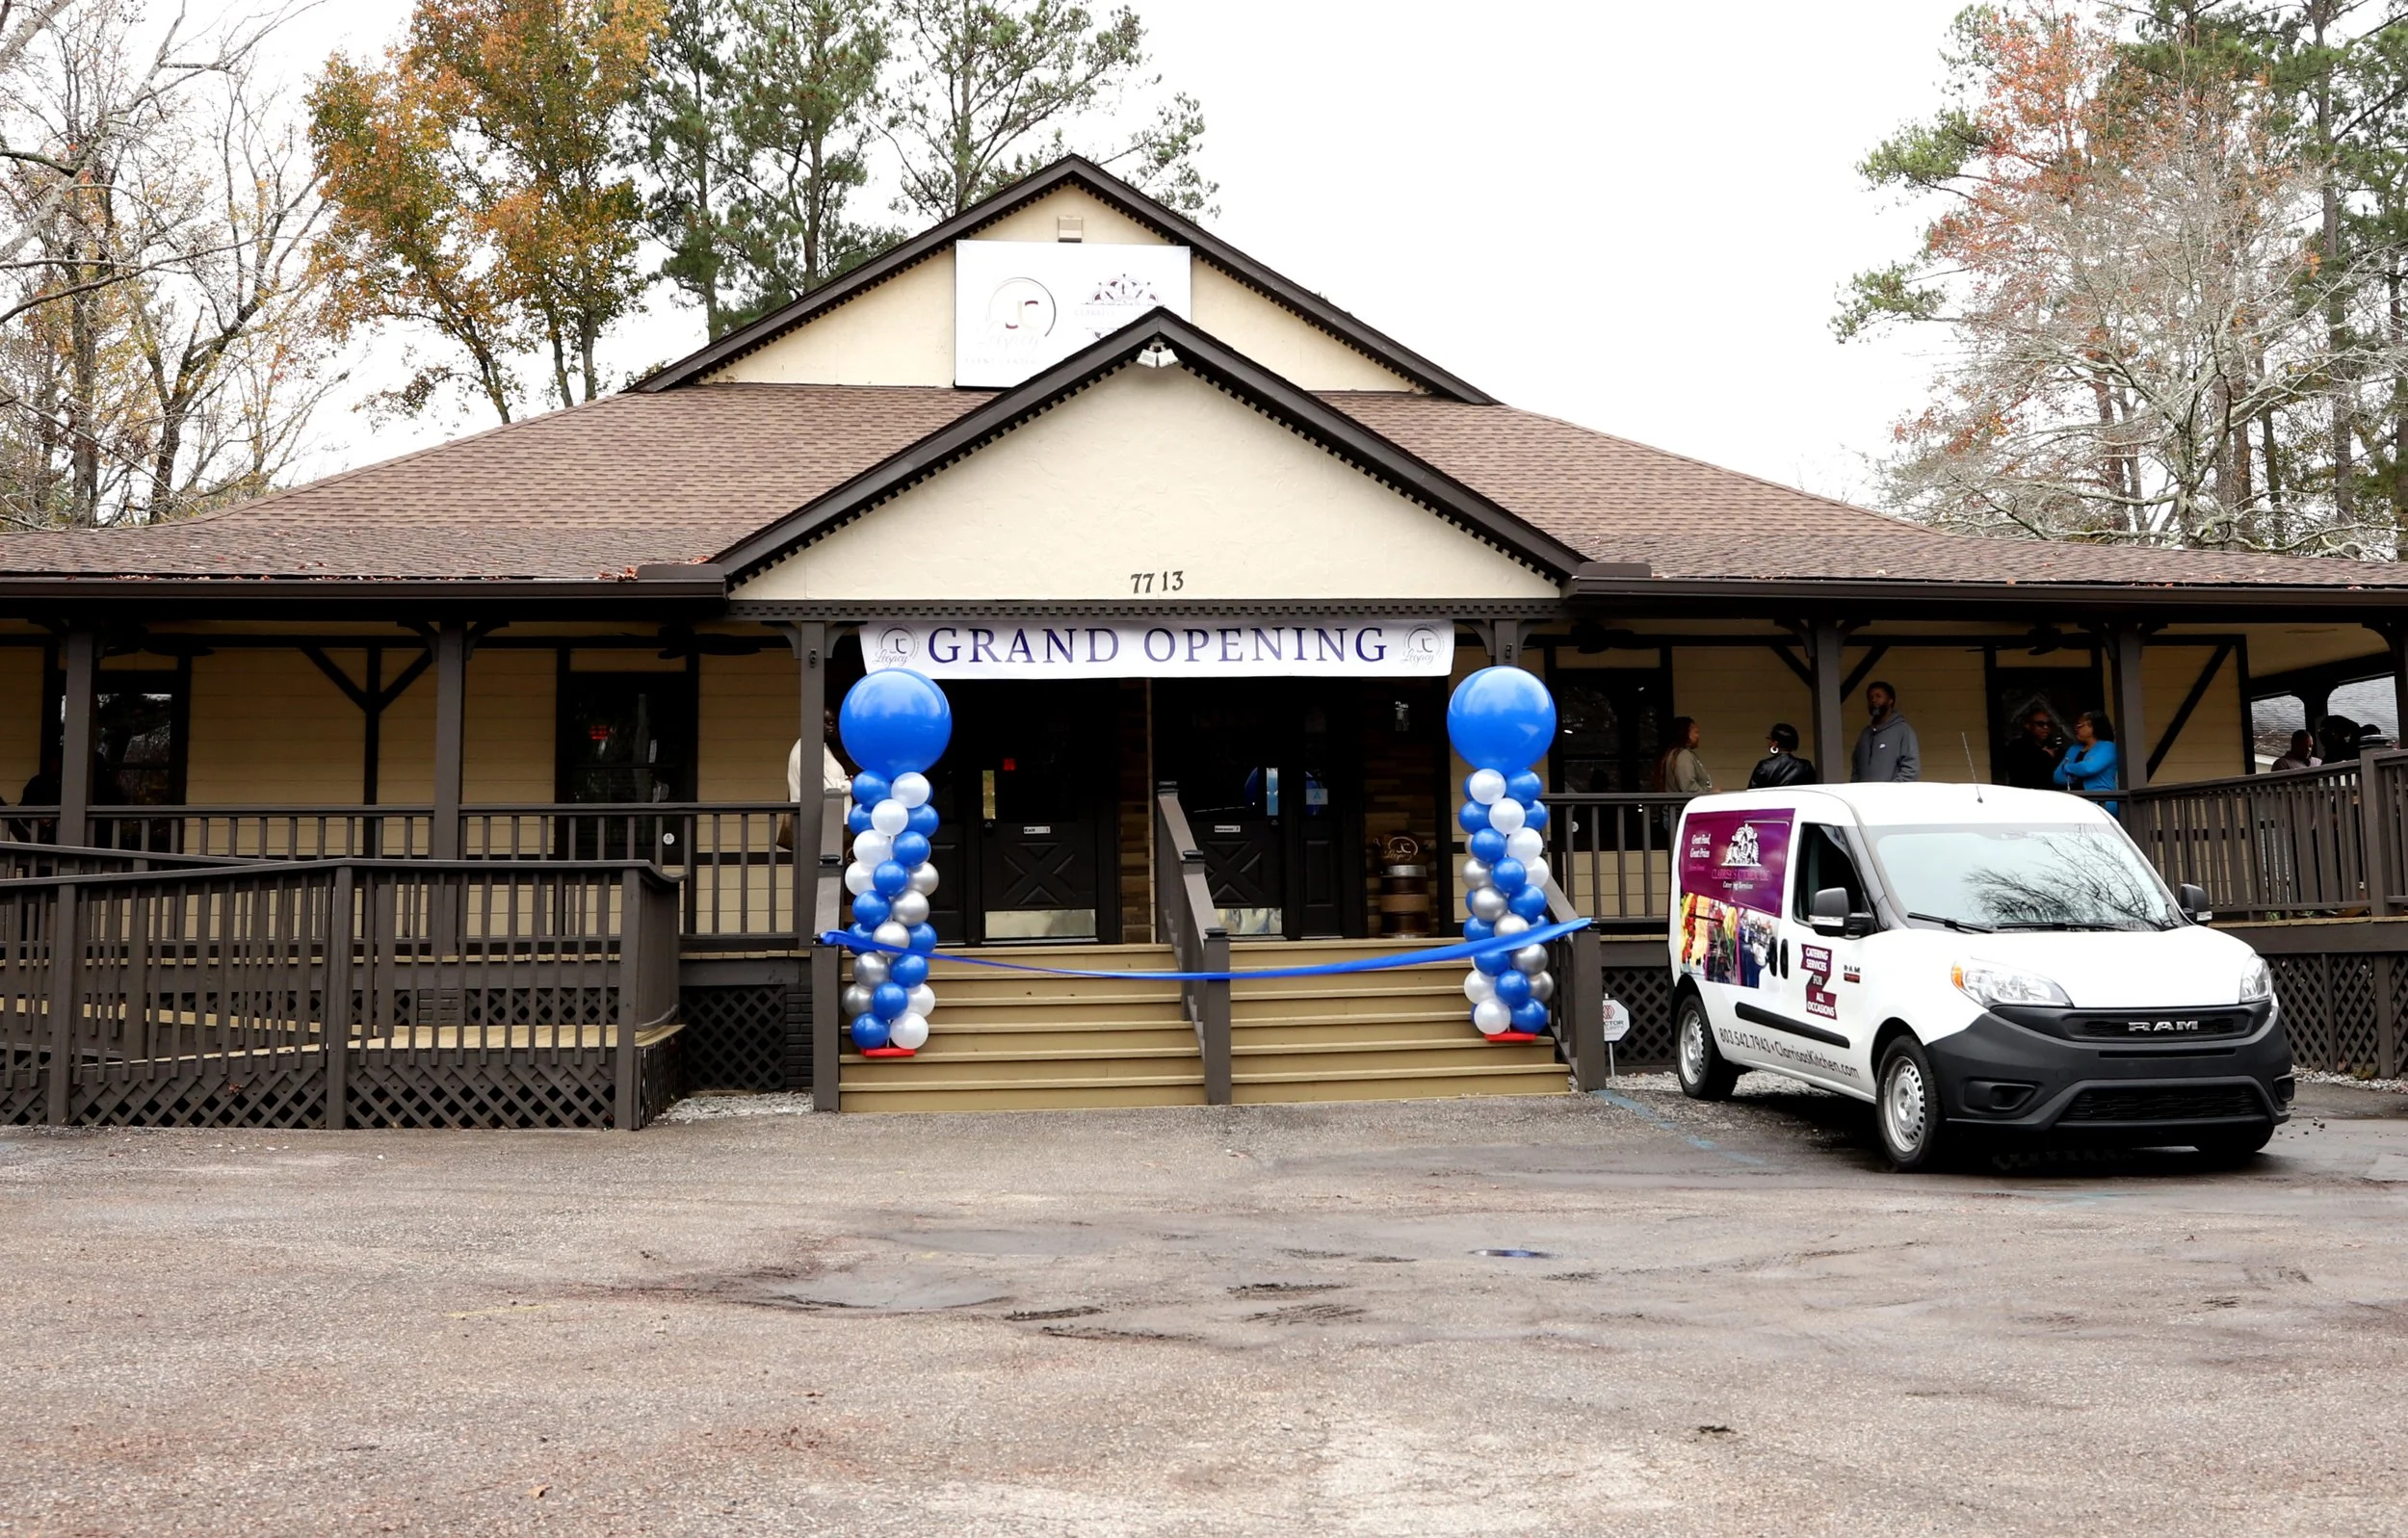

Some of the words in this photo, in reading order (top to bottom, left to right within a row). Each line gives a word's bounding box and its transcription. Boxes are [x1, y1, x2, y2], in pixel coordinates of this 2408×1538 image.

[1131, 570, 1184, 594] 7713
[929, 627, 1119, 664] GRAND
[1143, 627, 1387, 663] OPENING
[1805, 947, 1828, 961] CATERING
[1806, 958, 1827, 972] SERVICES
[1813, 975, 1823, 985] FOR
[1816, 992, 1824, 1003] ALL
[1807, 1001, 1835, 1017] OCCASIONS
[2128, 1021, 2198, 1031] RAM
